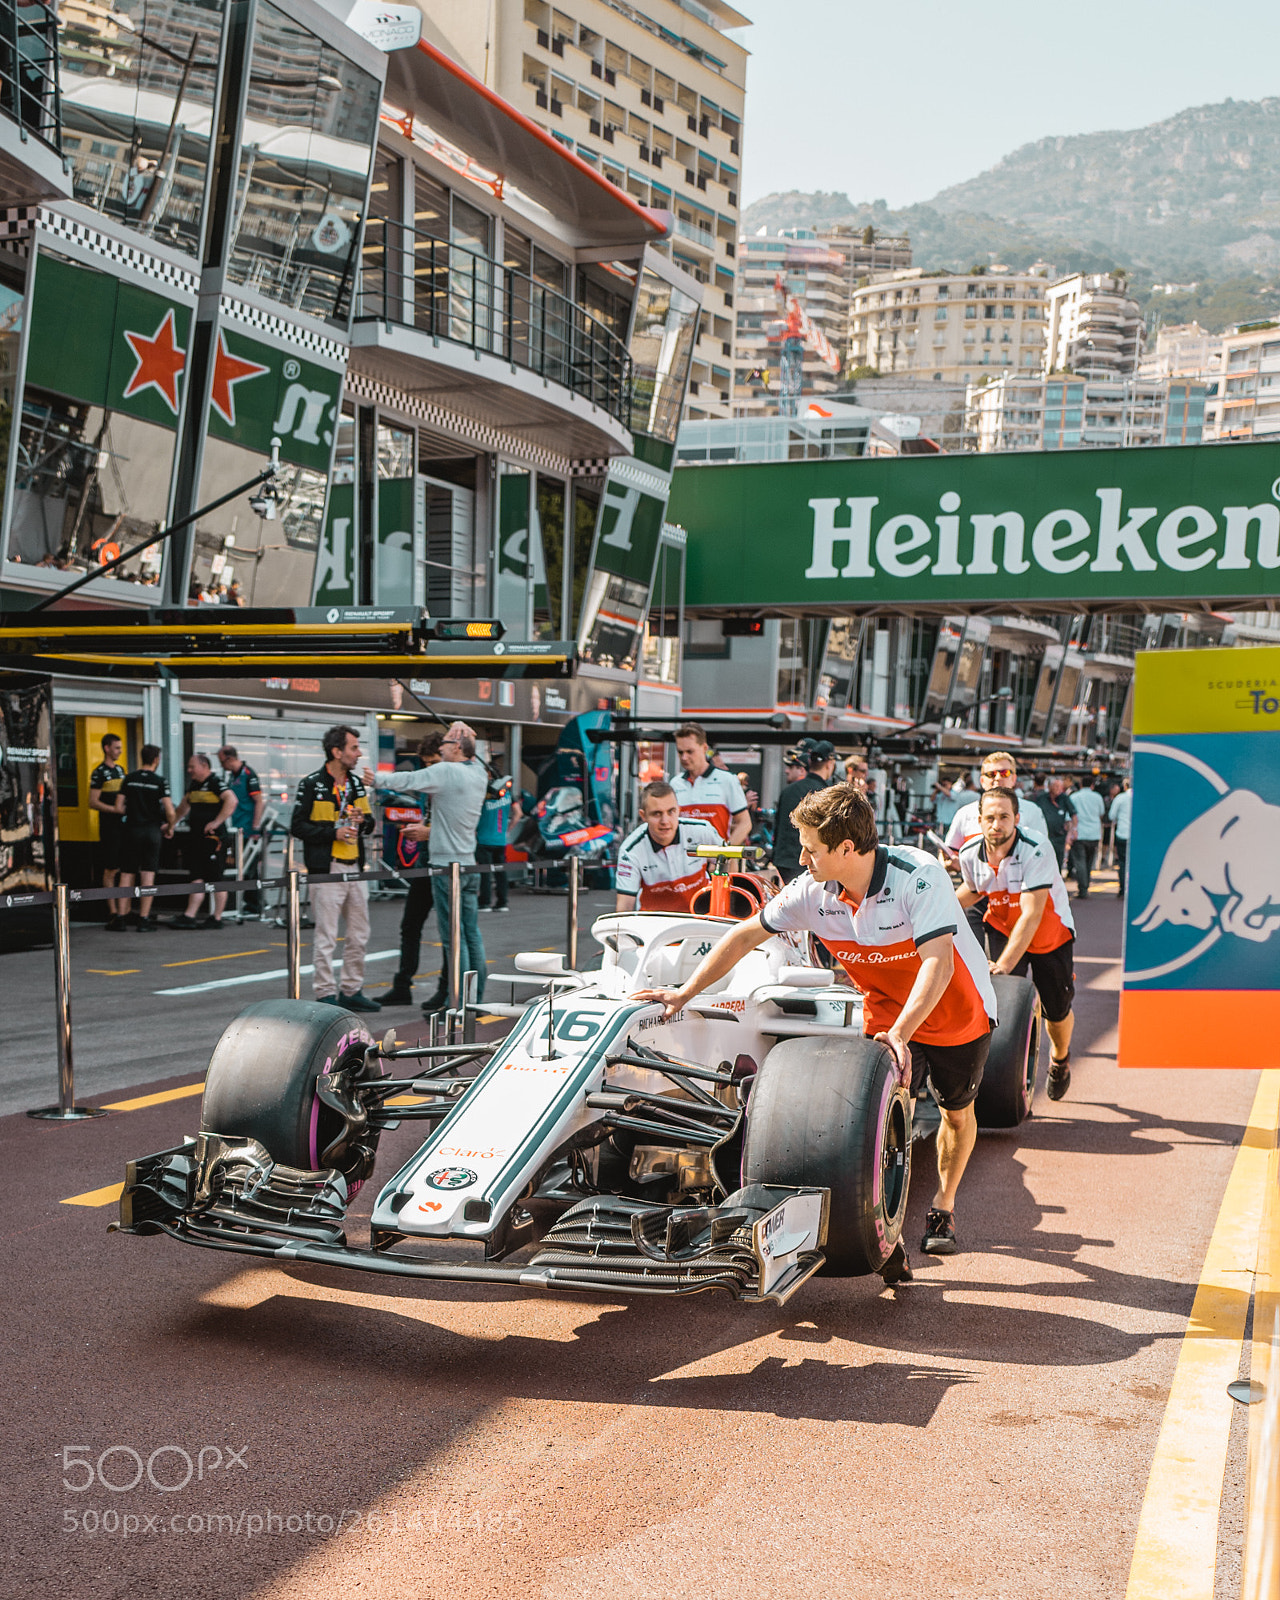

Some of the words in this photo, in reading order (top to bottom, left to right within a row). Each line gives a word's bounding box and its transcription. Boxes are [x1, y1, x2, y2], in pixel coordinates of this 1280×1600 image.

[805, 488, 1280, 578] Heineken
[1207, 680, 1278, 690] SCUDERIA
[836, 950, 866, 964] Alfa
[867, 950, 918, 964] Romeo
[540, 1009, 606, 1042] 16
